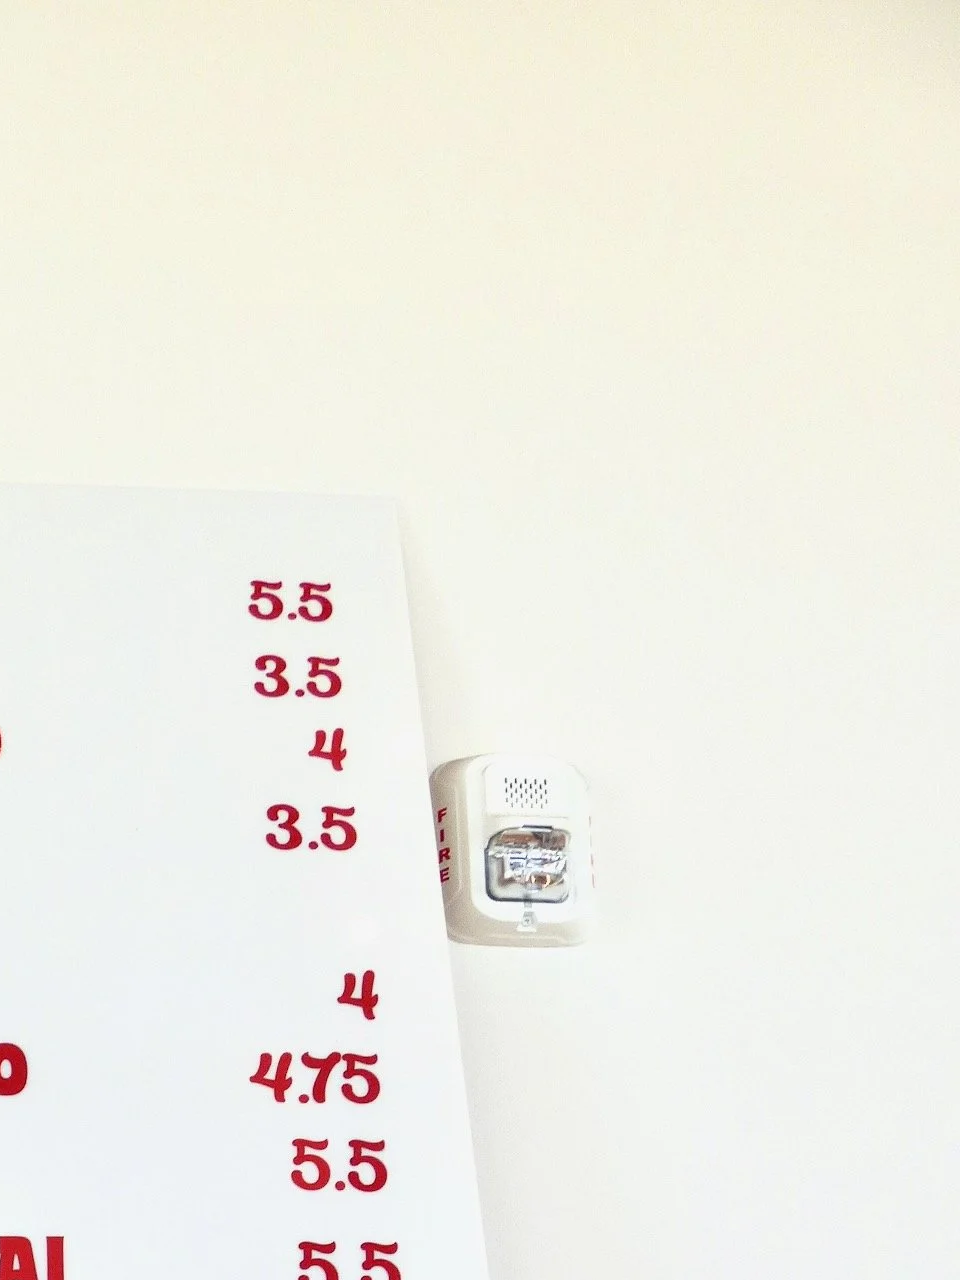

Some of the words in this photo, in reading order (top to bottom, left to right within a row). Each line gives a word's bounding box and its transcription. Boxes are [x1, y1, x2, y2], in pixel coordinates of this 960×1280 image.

[247, 579, 334, 623] 5.5
[253, 654, 343, 700] 3.5
[307, 727, 348, 773] 4
[264, 803, 358, 852] 3.5
[437, 806, 451, 884] FIRE
[337, 969, 380, 1021] 4
[249, 1051, 381, 1105] 4.75
[290, 1138, 389, 1194] 5.5
